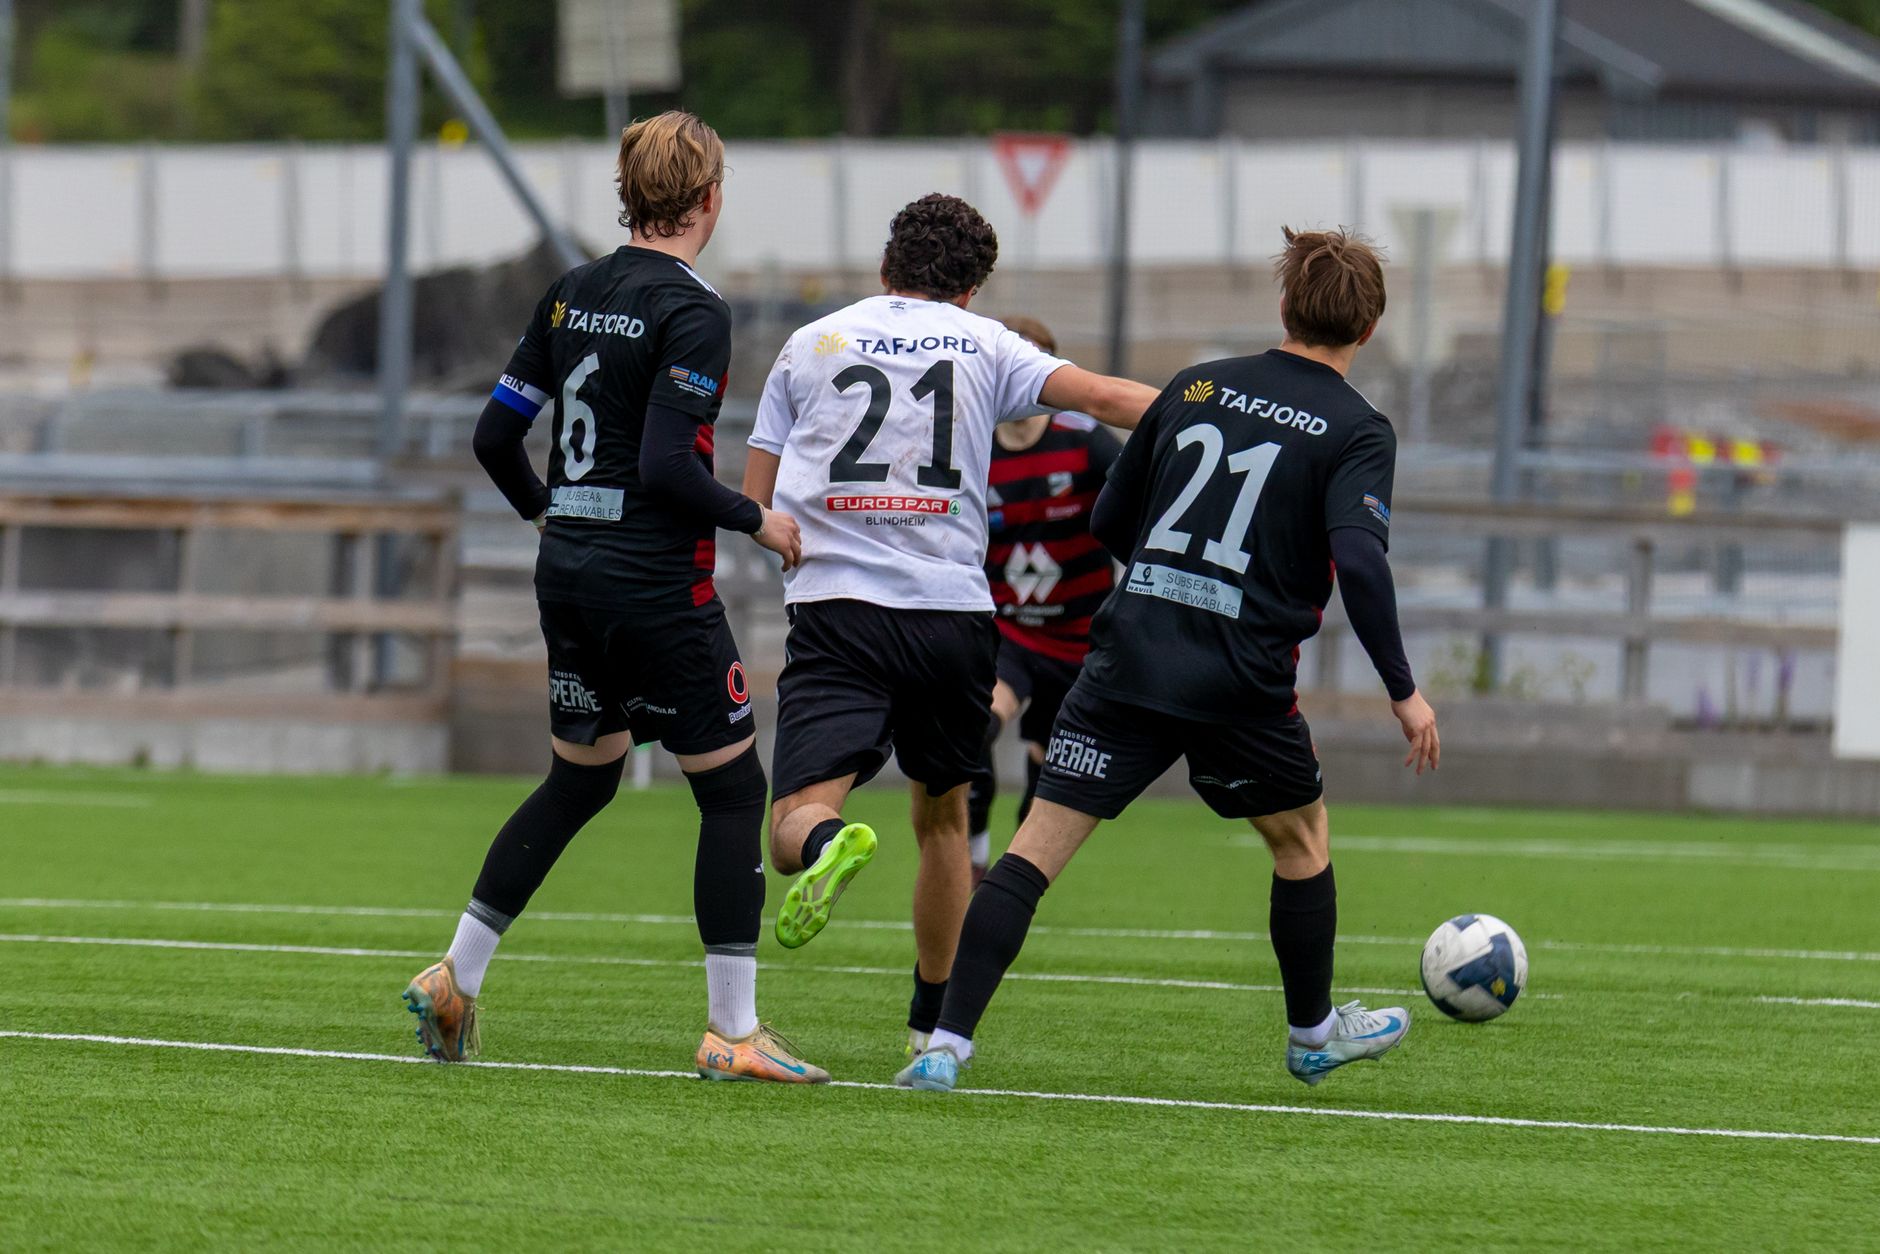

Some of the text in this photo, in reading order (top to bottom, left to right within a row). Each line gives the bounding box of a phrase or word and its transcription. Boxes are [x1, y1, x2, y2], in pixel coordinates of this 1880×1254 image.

[568, 308, 645, 339] TAFJORD
[856, 335, 978, 355] TAFJORD
[688, 371, 718, 393] RAM
[560, 352, 600, 482] 6
[829, 359, 963, 490] 21
[1219, 386, 1328, 436] TAFJORD
[833, 498, 943, 511] EUROSPAR
[1144, 422, 1283, 575] 21
[866, 516, 926, 526] BLINDHEIM
[1161, 587, 1238, 617] RENEWABLES
